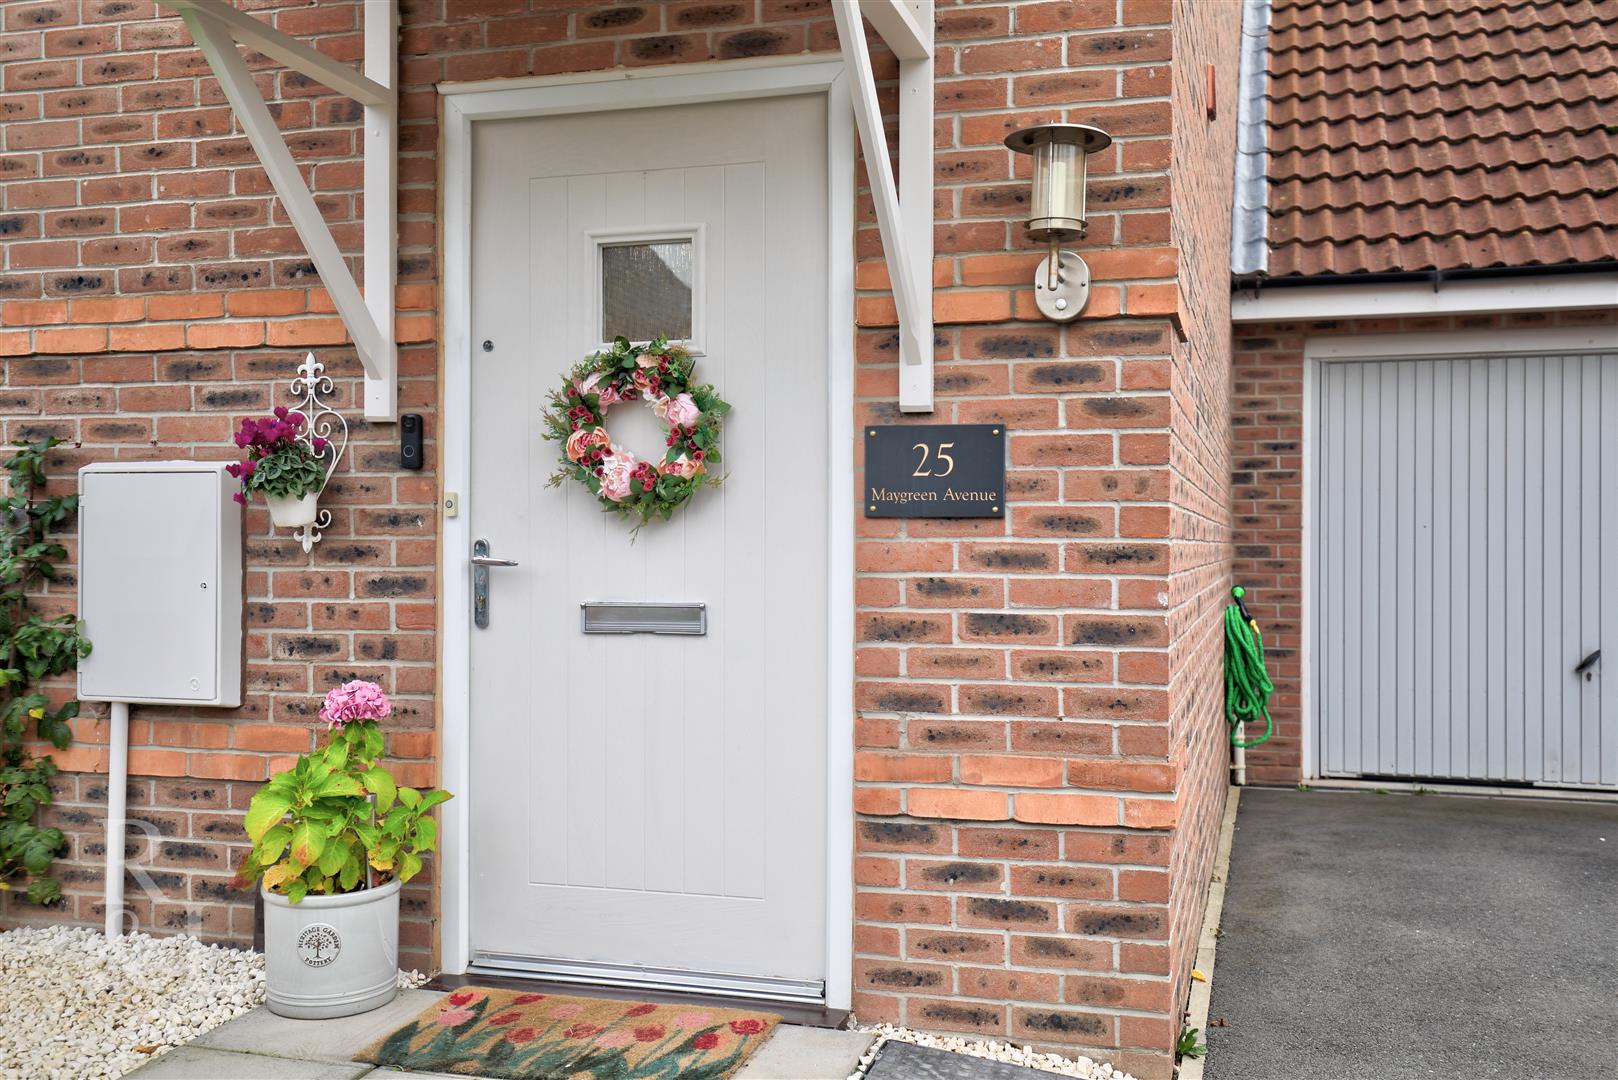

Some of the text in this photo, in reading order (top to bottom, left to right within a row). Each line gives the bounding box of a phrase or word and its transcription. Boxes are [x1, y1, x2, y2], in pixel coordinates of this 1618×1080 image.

[912, 442, 955, 477] 25
[871, 487, 997, 504] Maygreen Avenue
[298, 927, 339, 949] HERITAGE GARDEN
[305, 957, 331, 966] POTTERY
